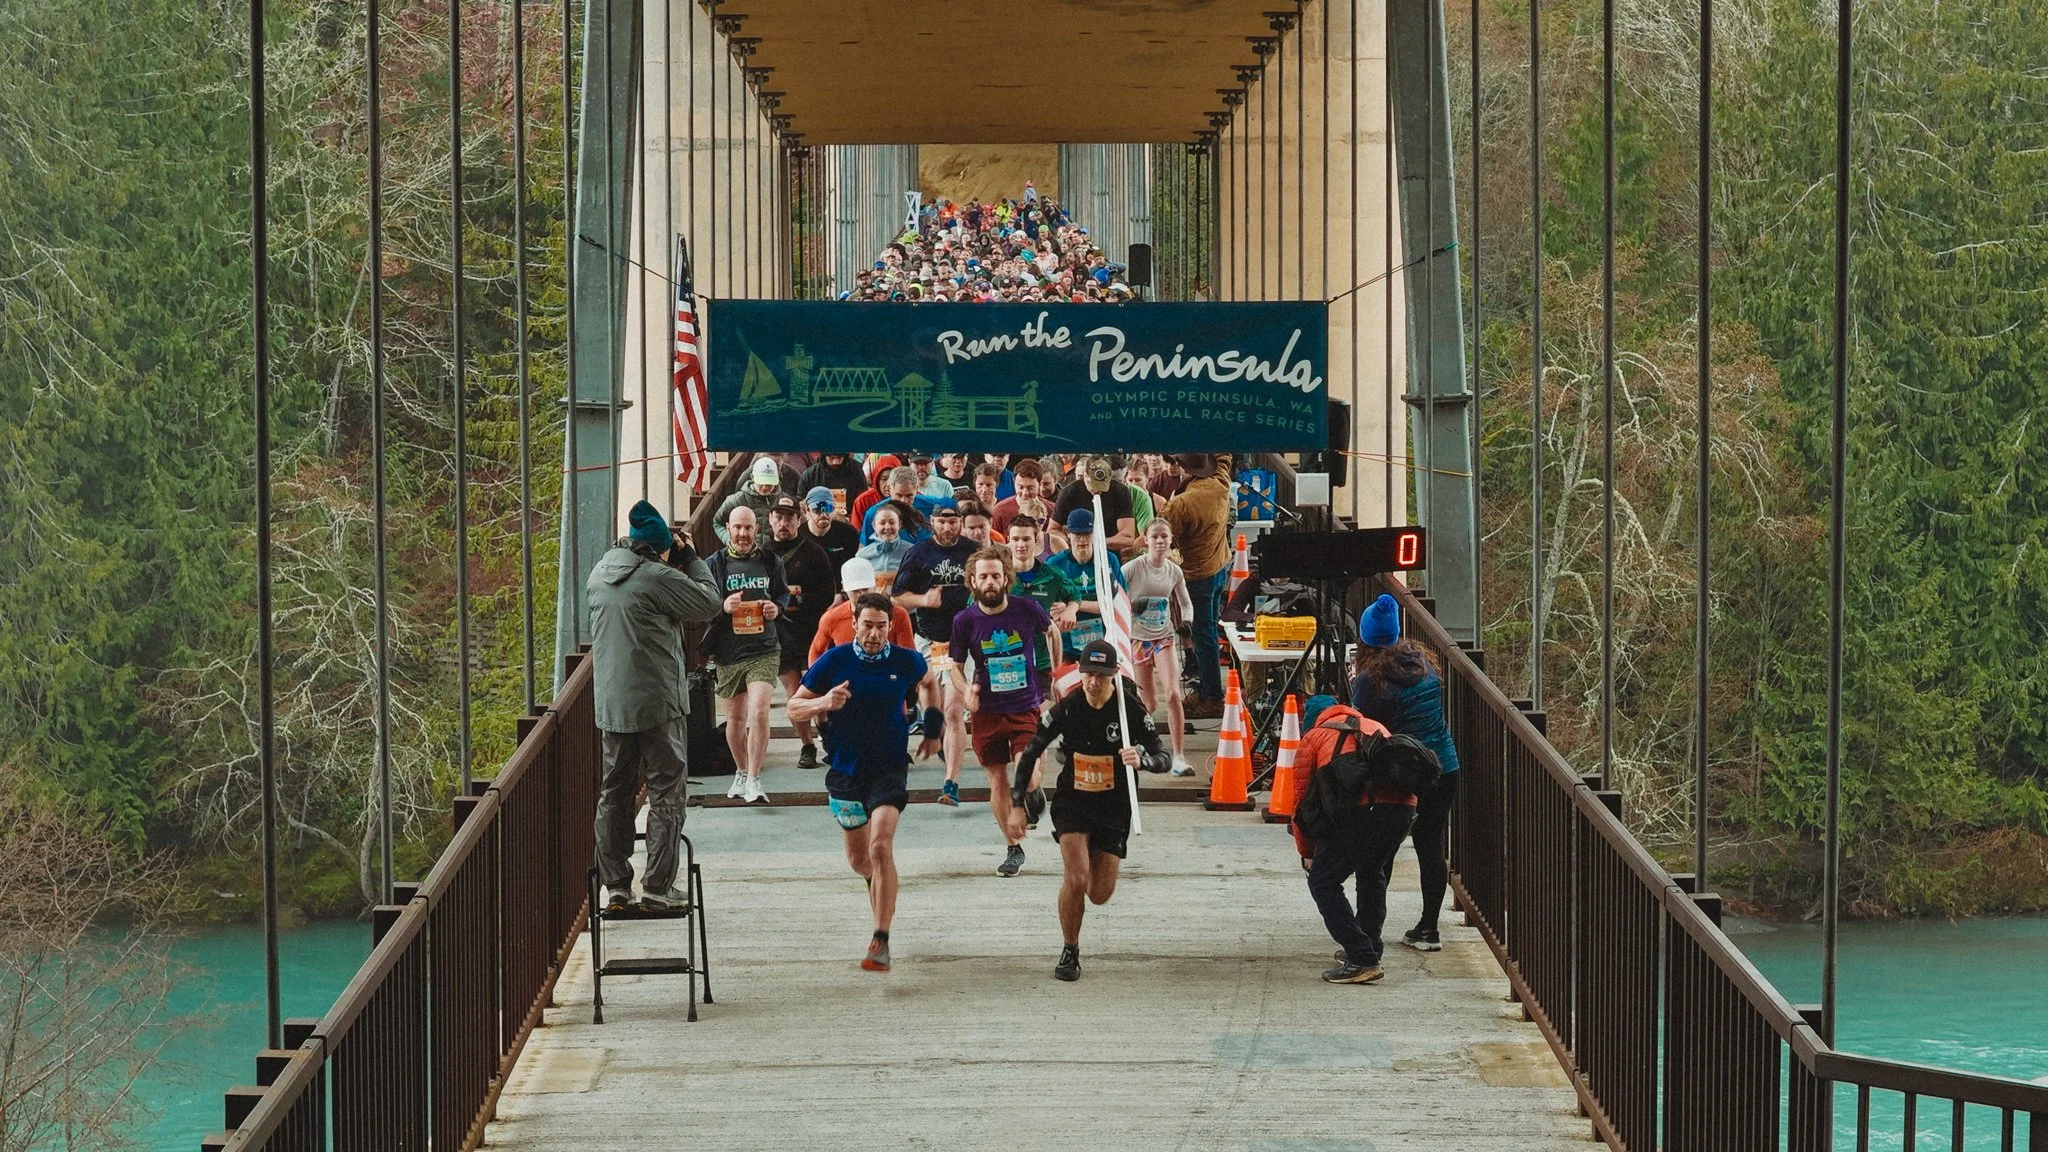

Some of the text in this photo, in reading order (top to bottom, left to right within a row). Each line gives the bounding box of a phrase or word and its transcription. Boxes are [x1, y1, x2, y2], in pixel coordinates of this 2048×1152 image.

[937, 311, 1323, 395] Run the Peninsula
[1091, 390, 1169, 404] OLYMPIC
[1291, 399, 1314, 415] WA
[1090, 407, 1316, 435] AND VIRTUAL RACE SERIES
[1398, 533, 1418, 566] 0
[745, 615, 753, 627] 8
[1079, 632, 1097, 645] 370
[998, 671, 1019, 684] 555
[1084, 771, 1104, 784] 111
